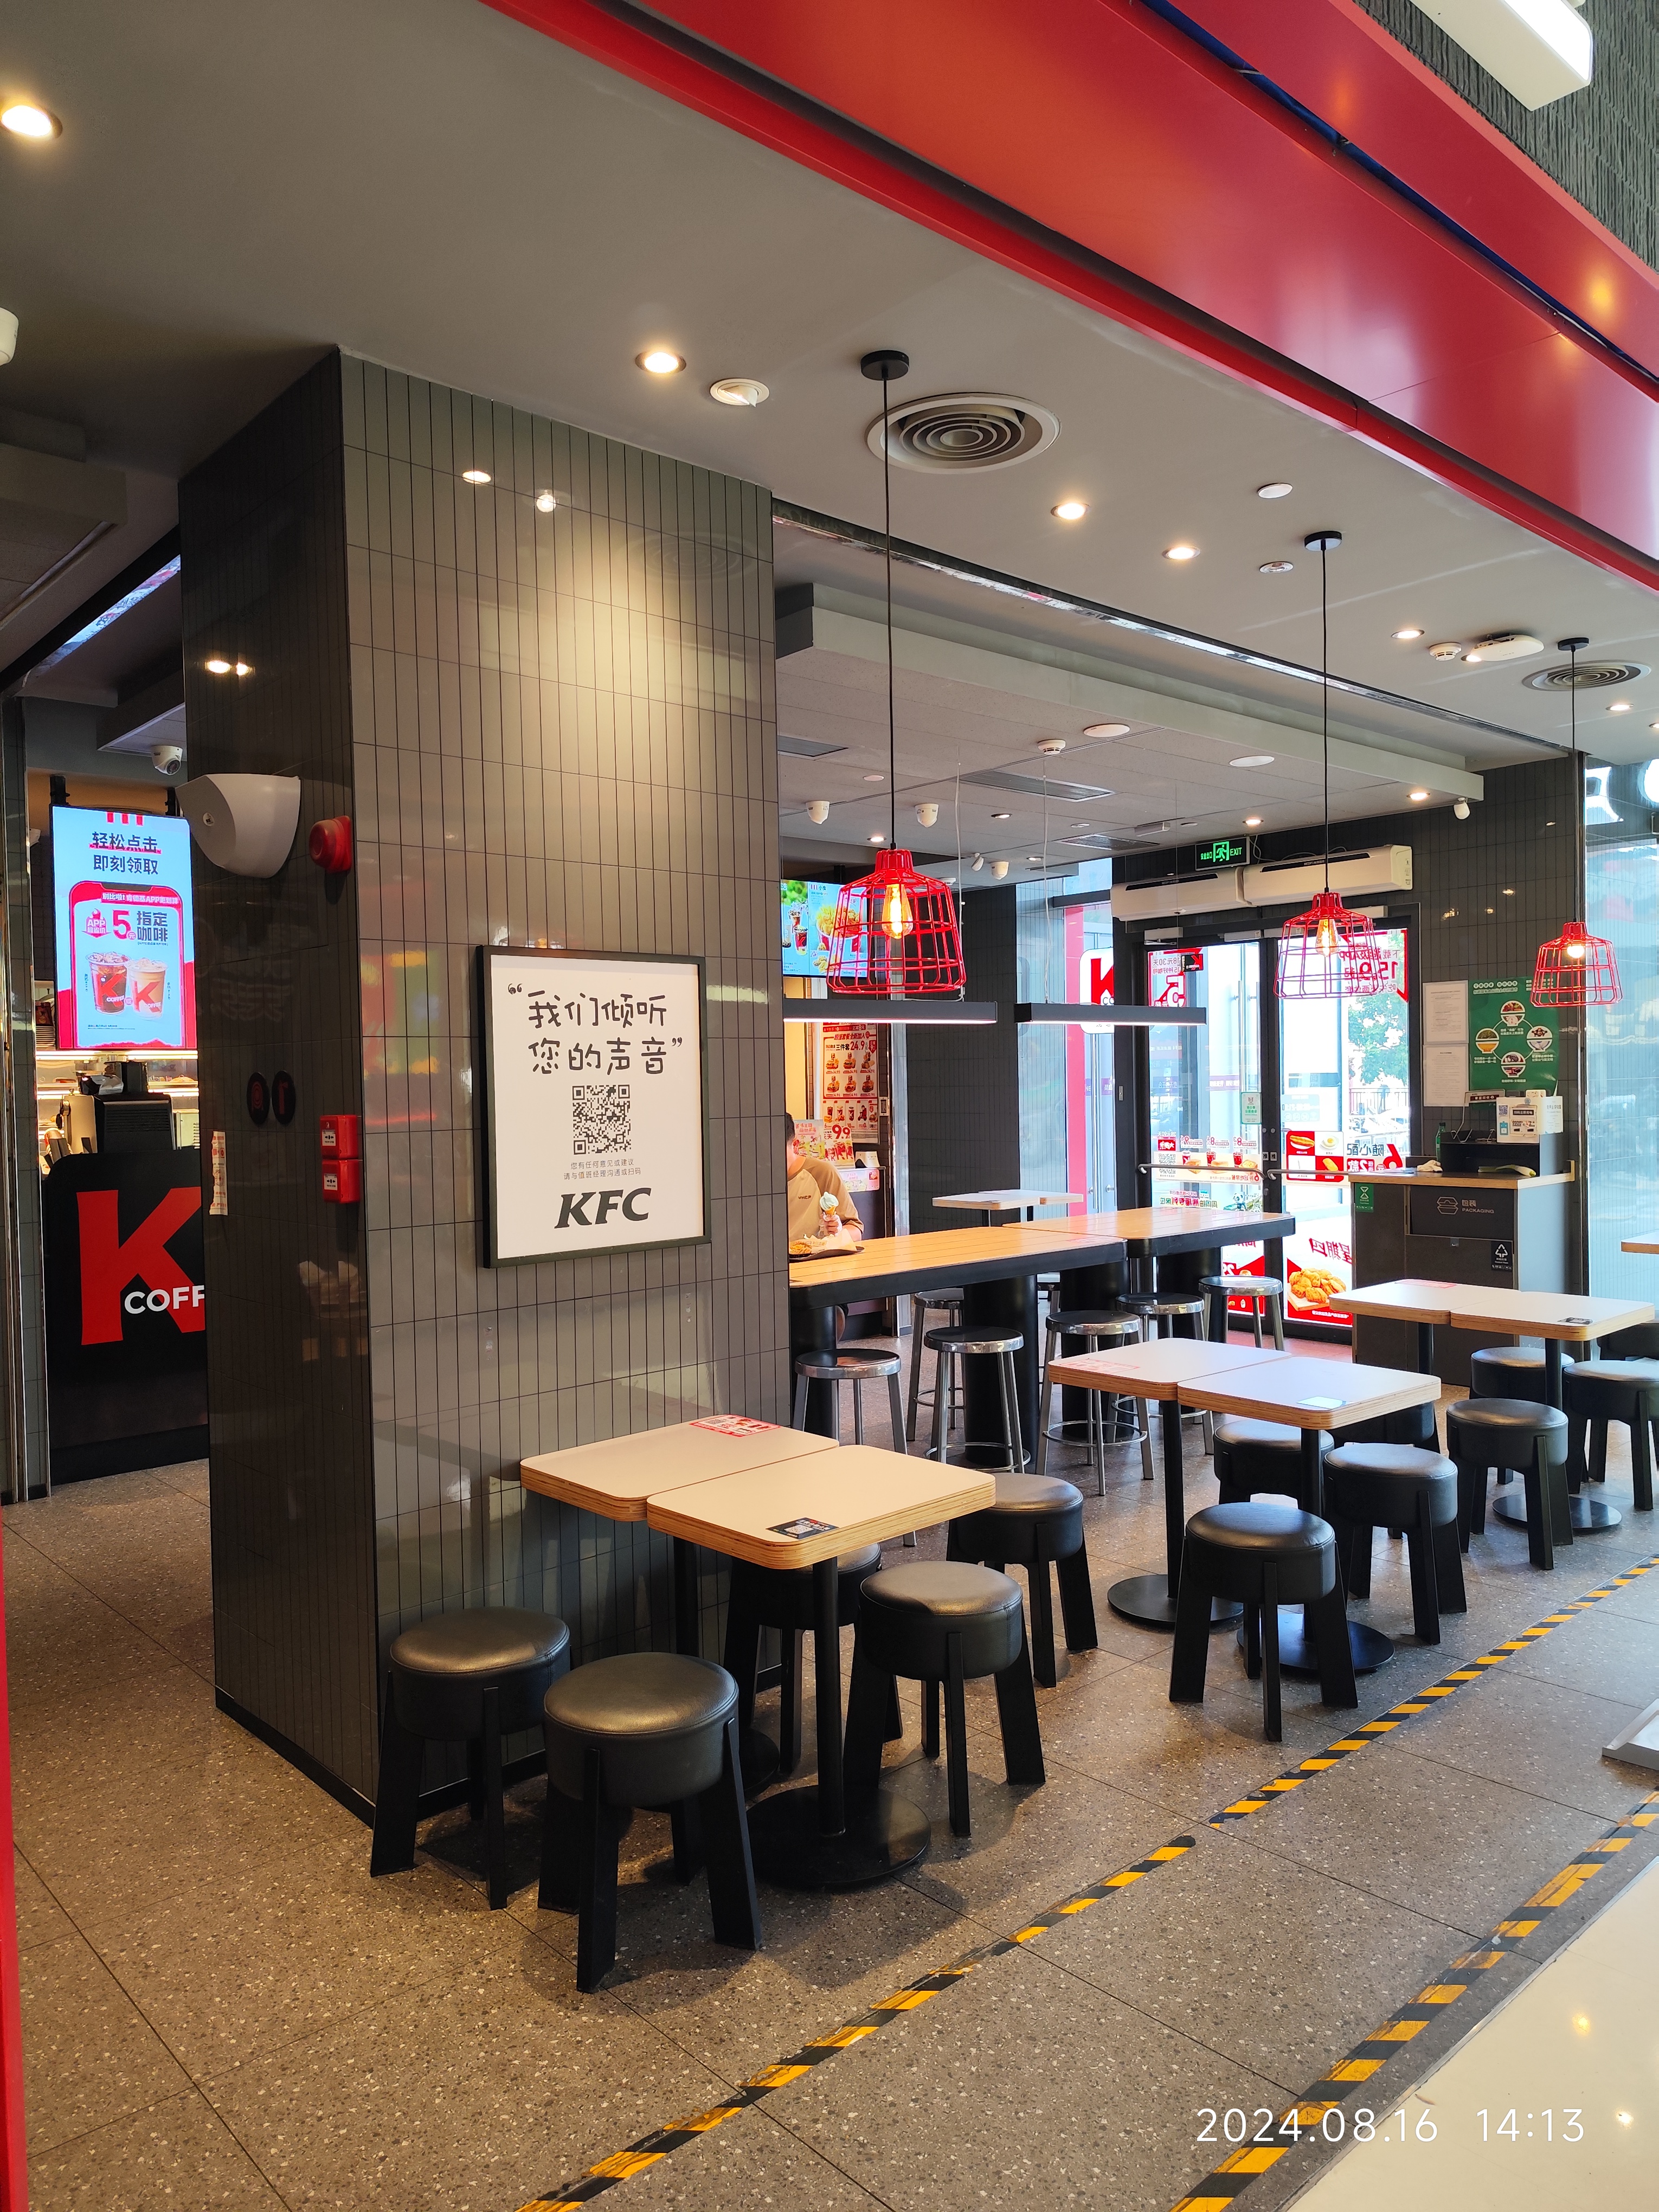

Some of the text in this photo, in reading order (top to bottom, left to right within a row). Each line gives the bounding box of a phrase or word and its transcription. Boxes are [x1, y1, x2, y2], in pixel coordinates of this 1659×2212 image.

[92, 831, 158, 853] 轻松点击
[1200, 851, 1212, 860] 安全出口
[1230, 847, 1242, 856] EXIT
[93, 854, 159, 874] 即刻领取
[87, 919, 106, 927] APP
[137, 911, 168, 927] 指定
[137, 926, 168, 942] 咖啡
[850, 1040, 865, 1051] 24.9
[570, 1158, 634, 1170] 您有任何意见或建议
[563, 1167, 641, 1180] 请与值班经理沟通或扫码
[554, 1187, 652, 1229] KFC
[1462, 1199, 1477, 1207] 包装
[76, 1186, 205, 1346] K
